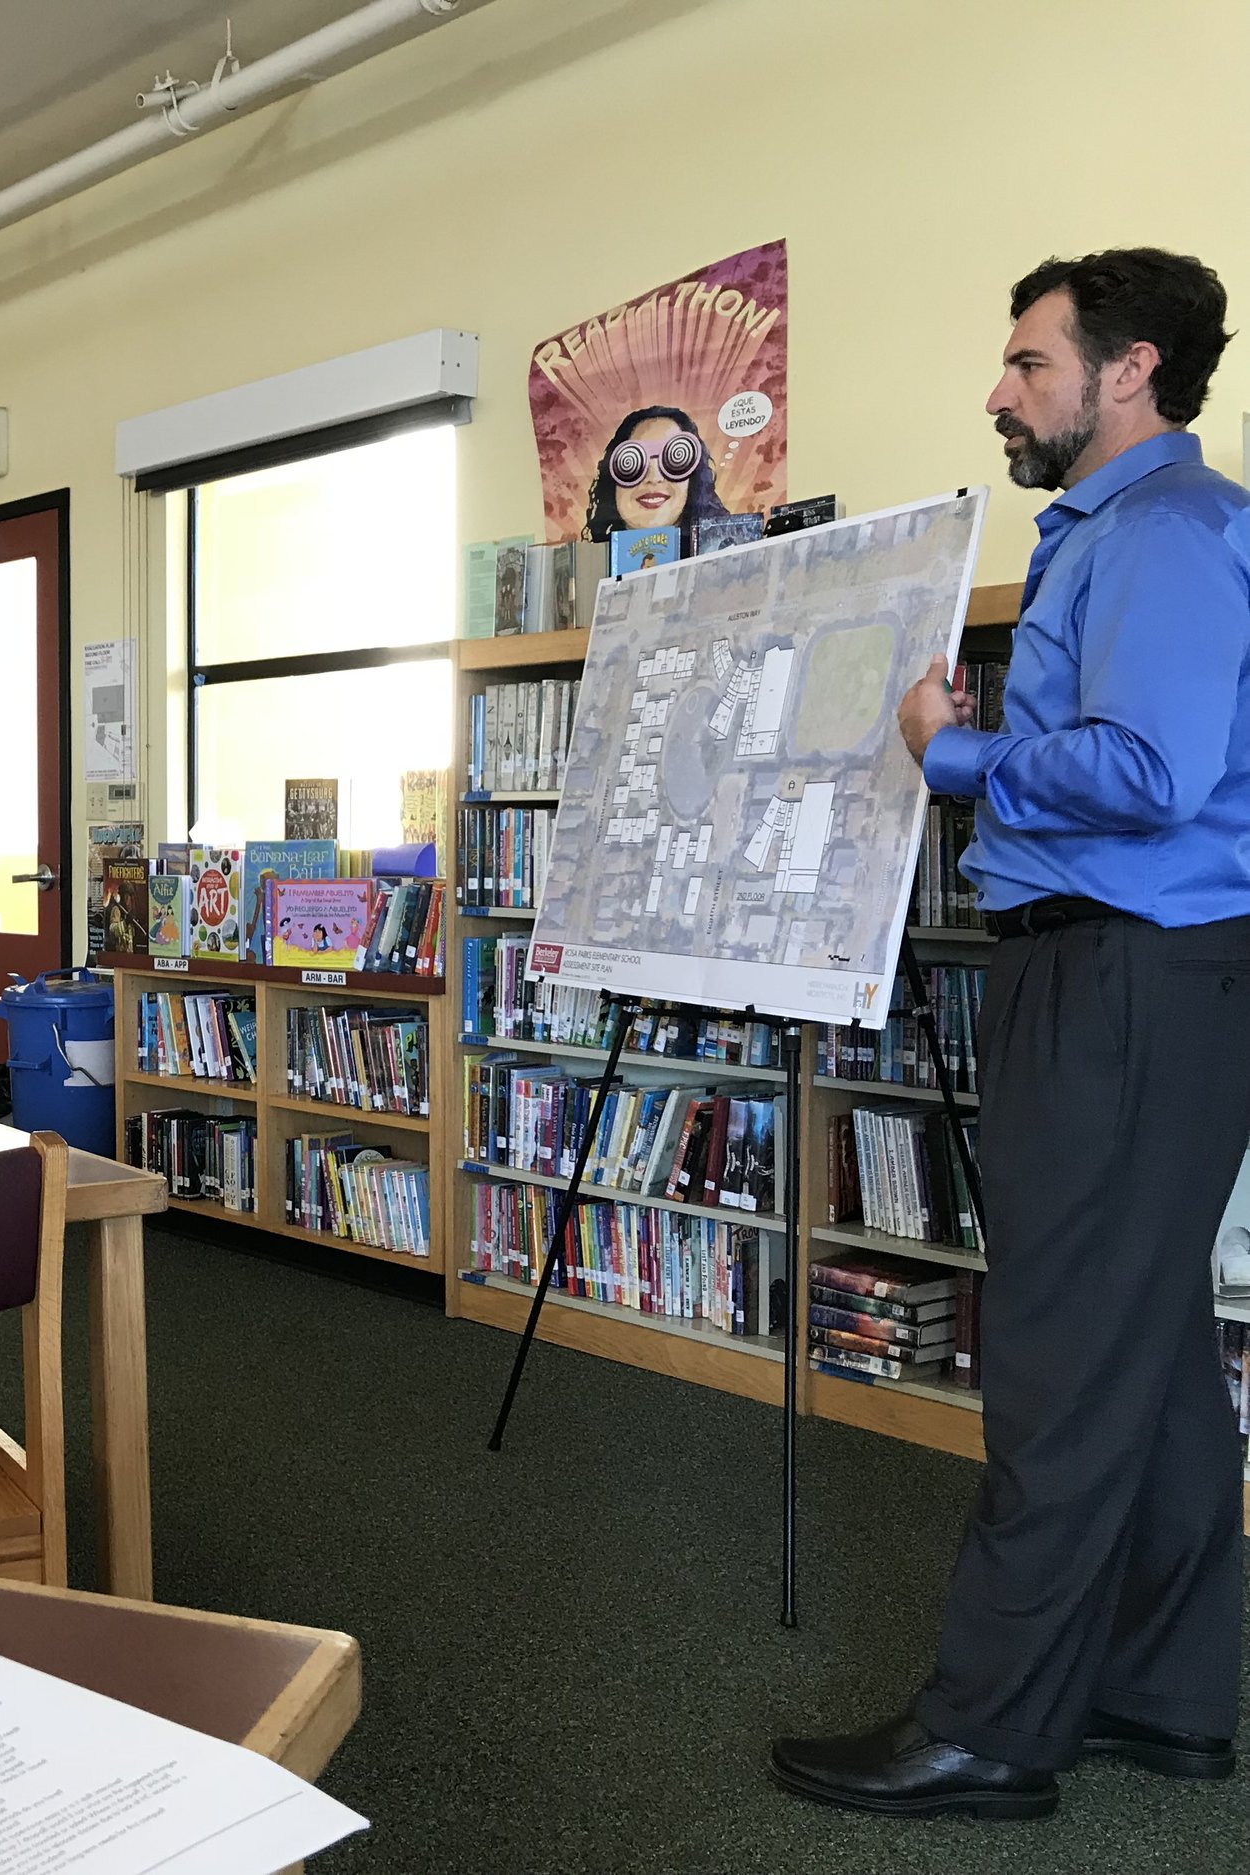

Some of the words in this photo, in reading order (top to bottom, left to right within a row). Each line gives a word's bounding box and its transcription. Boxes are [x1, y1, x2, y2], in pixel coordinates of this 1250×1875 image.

[732, 406, 756, 418] ESTAS
[726, 415, 766, 430] LEYENDO?
[290, 787, 333, 800] GETTYSBURG
[108, 866, 144, 880] FIREFIGHTERS
[199, 887, 228, 918] ART
[536, 946, 560, 958] Berkeley
[156, 959, 170, 968] ABA
[174, 960, 188, 969] APP
[622, 954, 642, 964] SCHOOL
[306, 974, 322, 982] ARM
[328, 974, 344, 983] BAR
[853, 982, 879, 1010] HY
[891, 1179, 900, 1204] BROWN
